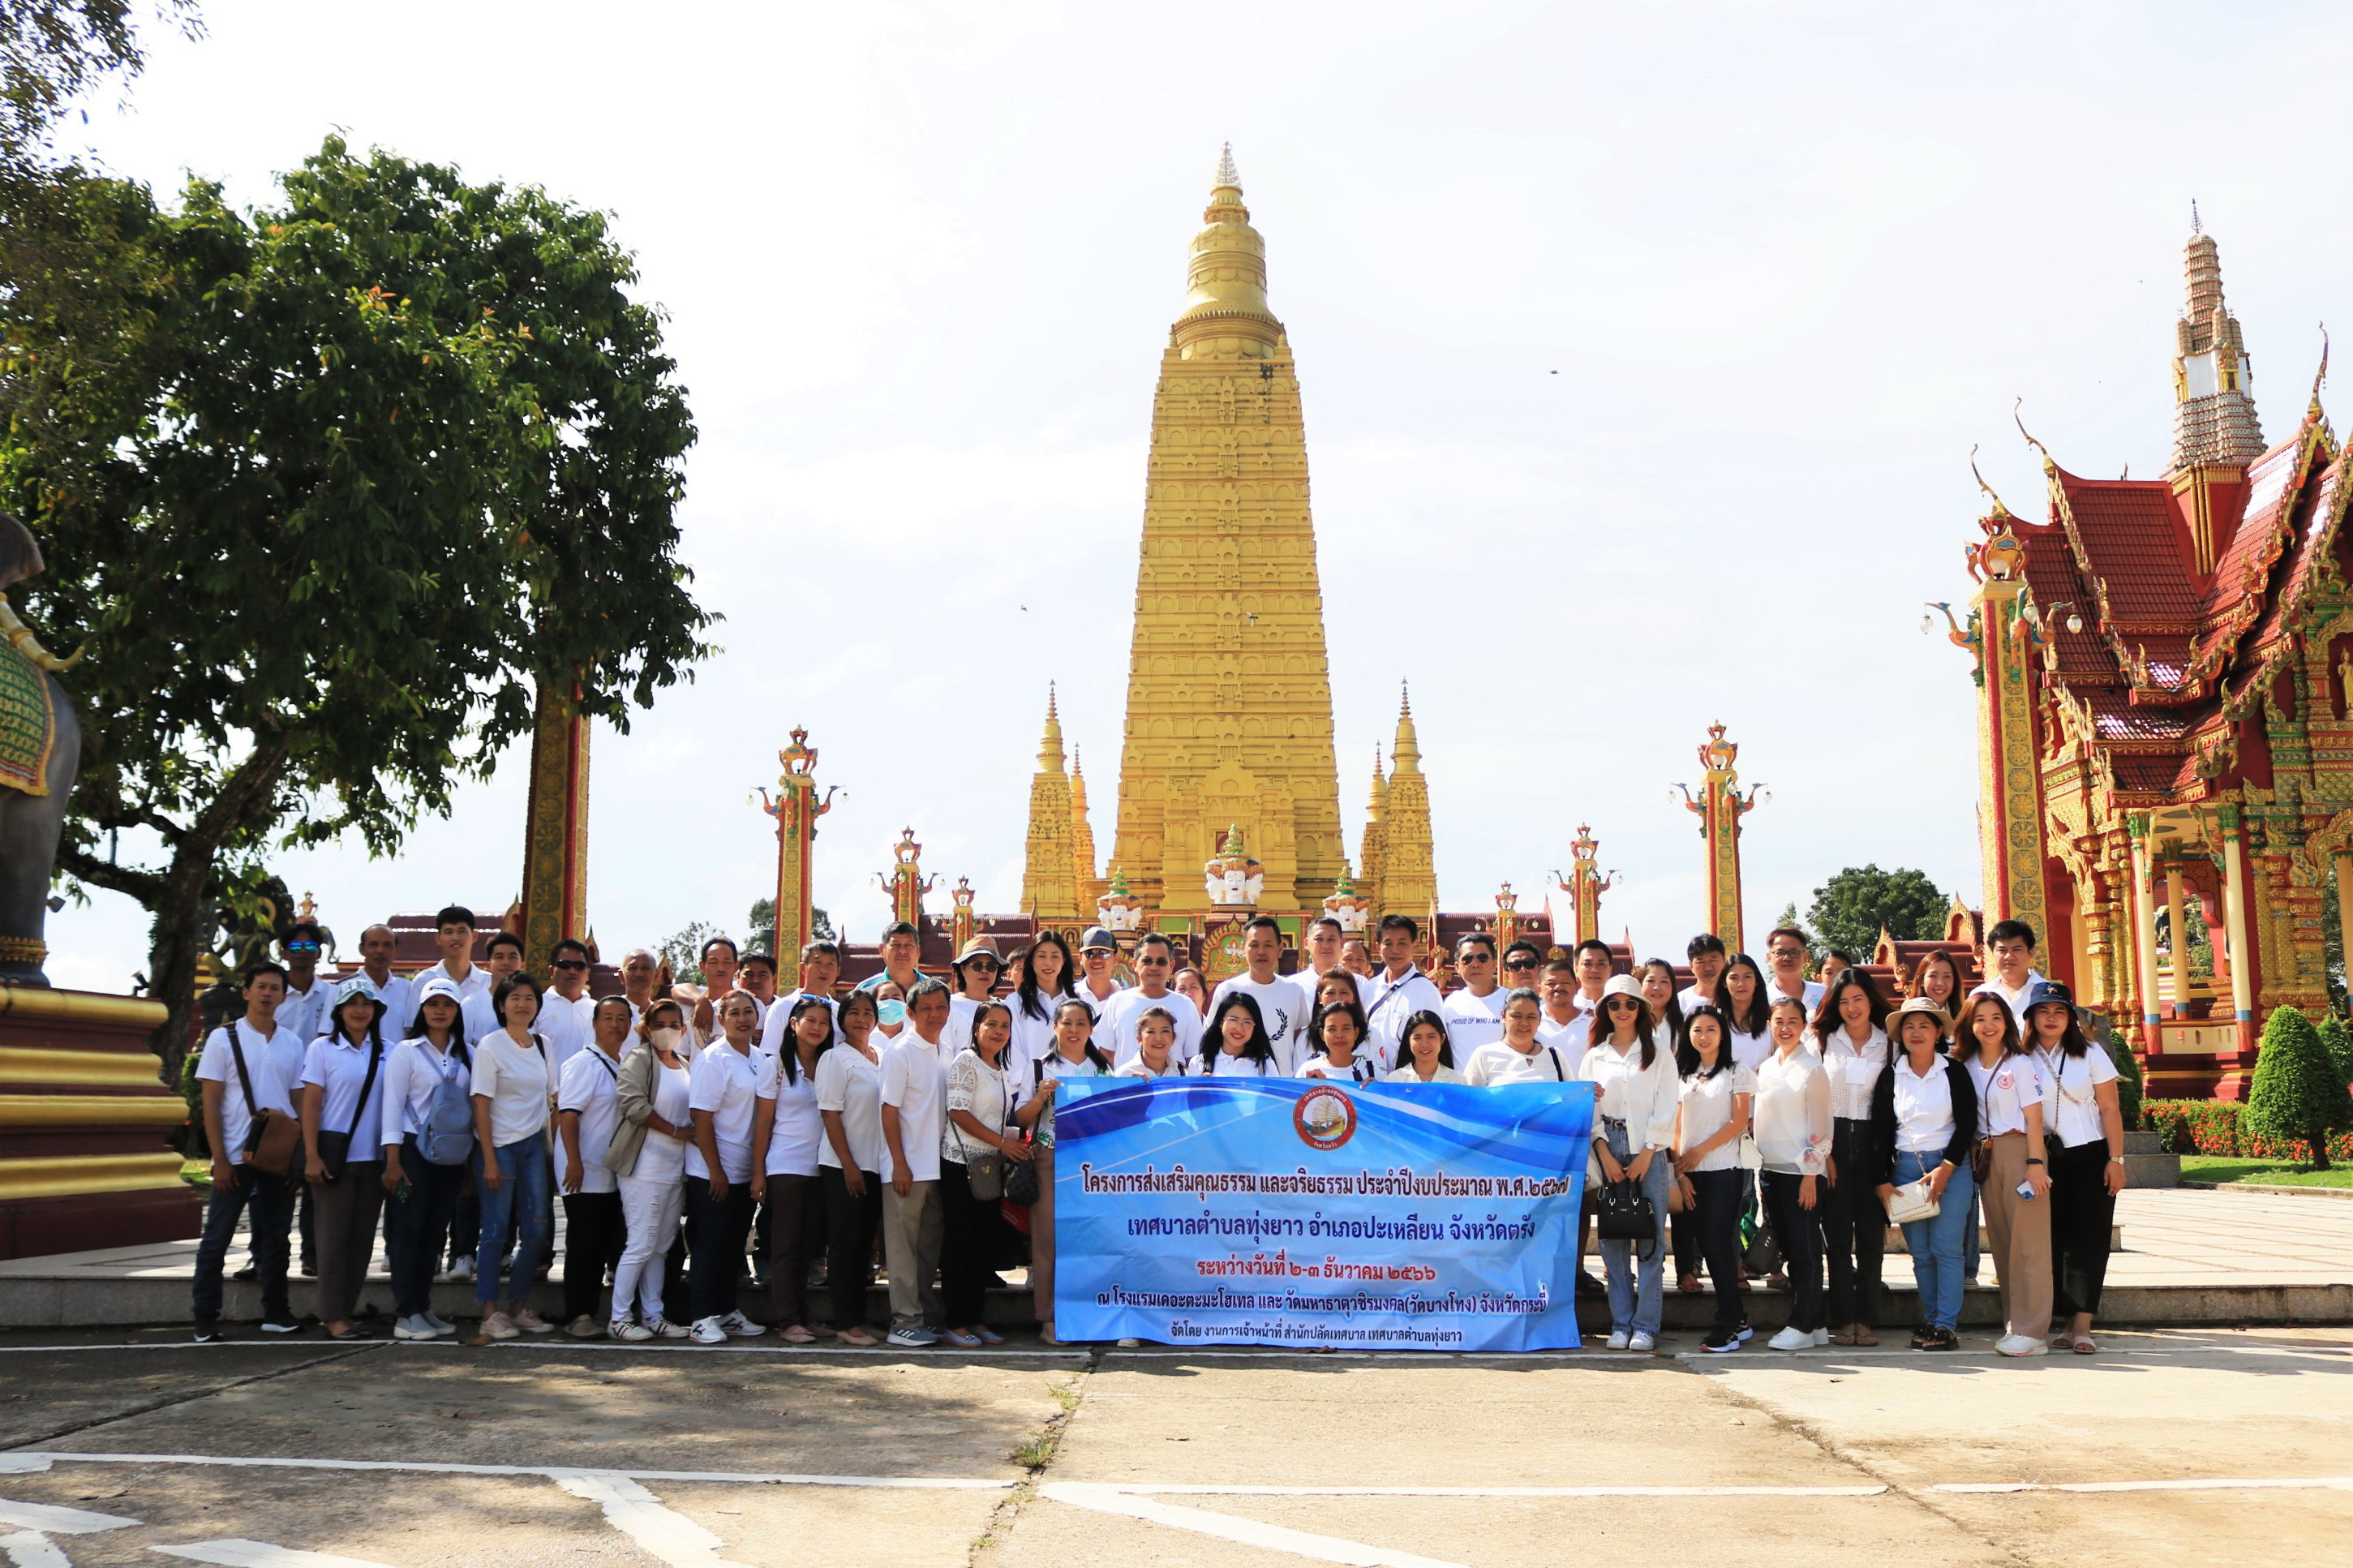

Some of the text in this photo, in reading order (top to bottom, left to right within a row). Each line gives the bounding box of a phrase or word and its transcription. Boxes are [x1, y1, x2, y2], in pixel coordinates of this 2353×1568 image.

[1082, 1164, 1569, 1201] โครงการส่งเสริมคุณธรรม และจริยธรรม ประจำปีงบประมาณ พ.ศ.๒๕๖๗
[1128, 1209, 1535, 1244] เทศบาลตำบลทุ่งยาว อำเภอปะเหลียน จังหวัดตรัง
[1197, 1249, 1436, 1281] ระหว่างวันที่ ๒-๓ ธันวาคม ๒๕๖๖
[1097, 1285, 1547, 1318] ณ โรงแรมเดอะตะมะโฮเทล และ วัดมหาธาตุวชิรมงคล(วัดบางโทง) จังหวัดกระบี่
[1171, 1318, 1462, 1347] จัดโดย งานการเจ้าหน้าที่ สำนักปลัดเทศบาล เทศบาลตำบลทุ่งยาว
